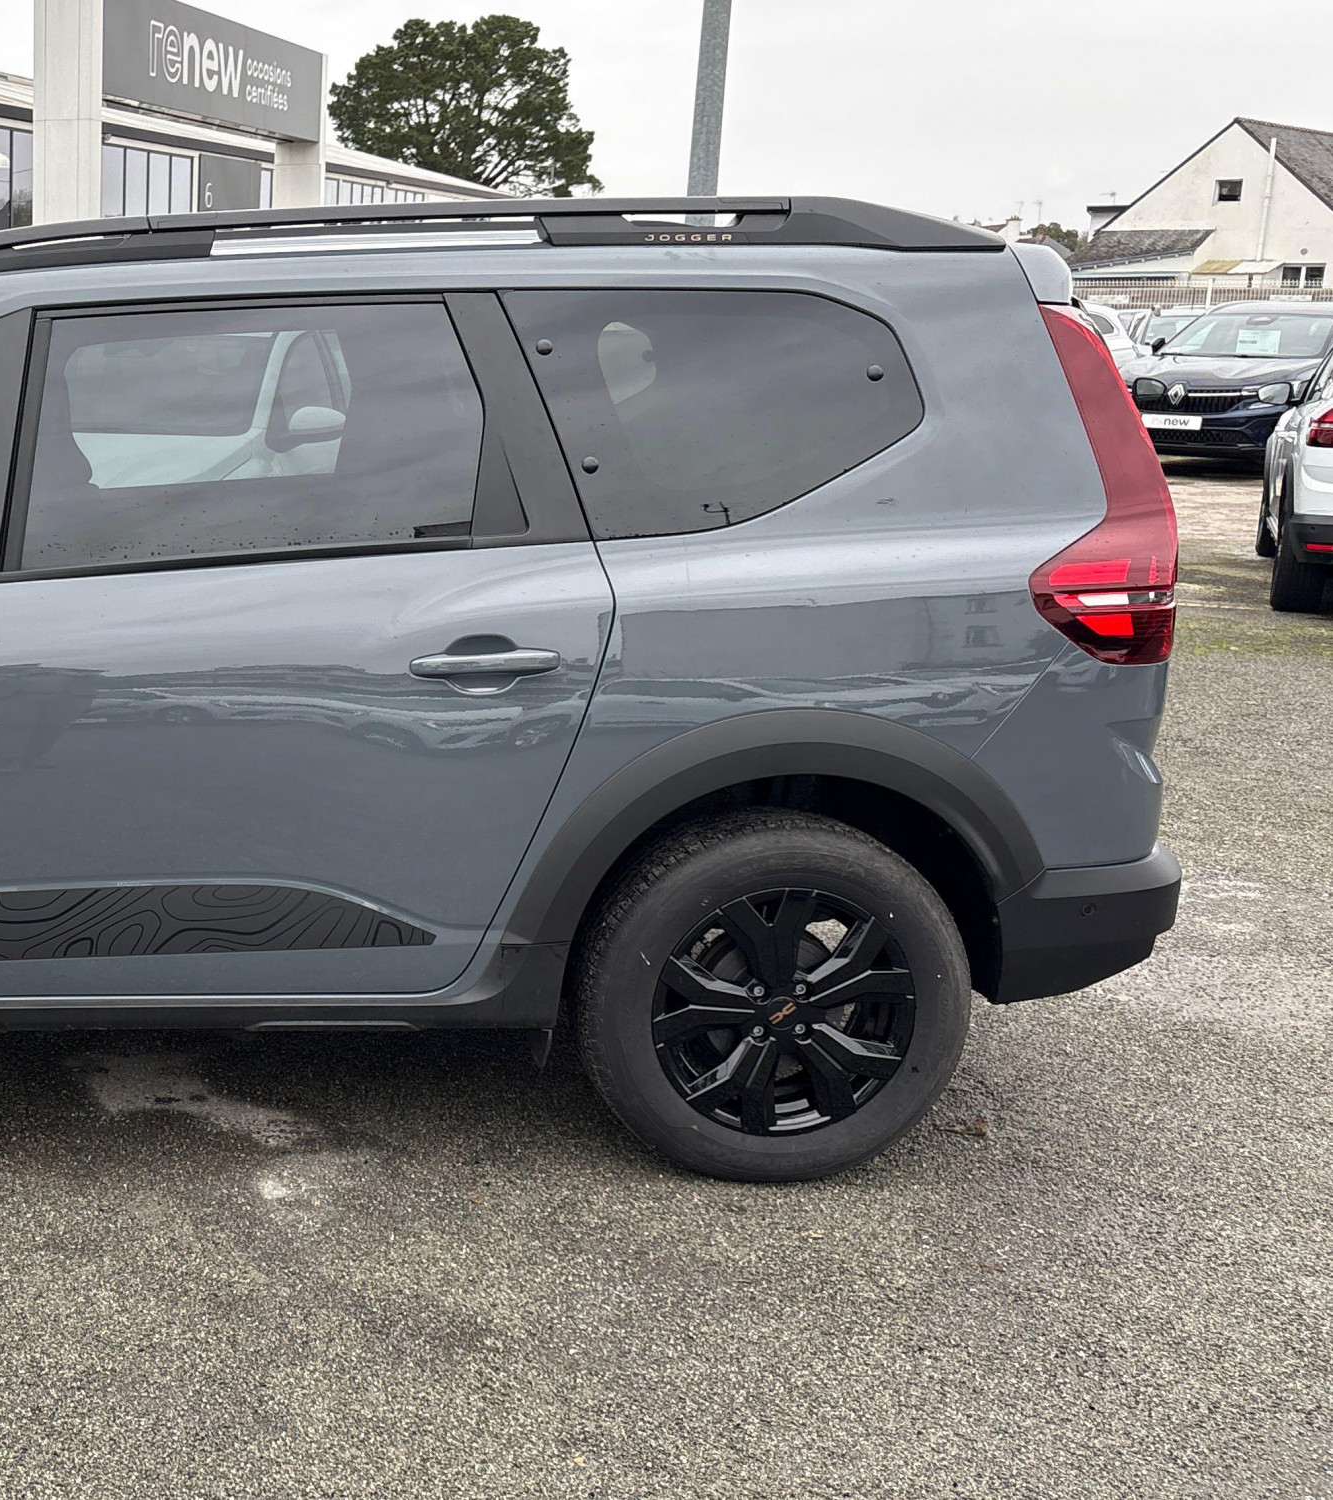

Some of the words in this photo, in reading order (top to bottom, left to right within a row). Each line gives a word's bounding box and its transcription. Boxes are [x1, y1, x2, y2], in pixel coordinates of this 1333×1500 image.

[149, 20, 244, 98] renew
[246, 58, 292, 87] occasions
[245, 84, 288, 111] certifiées
[204, 182, 213, 208] 6
[644, 234, 733, 242] JOGGER
